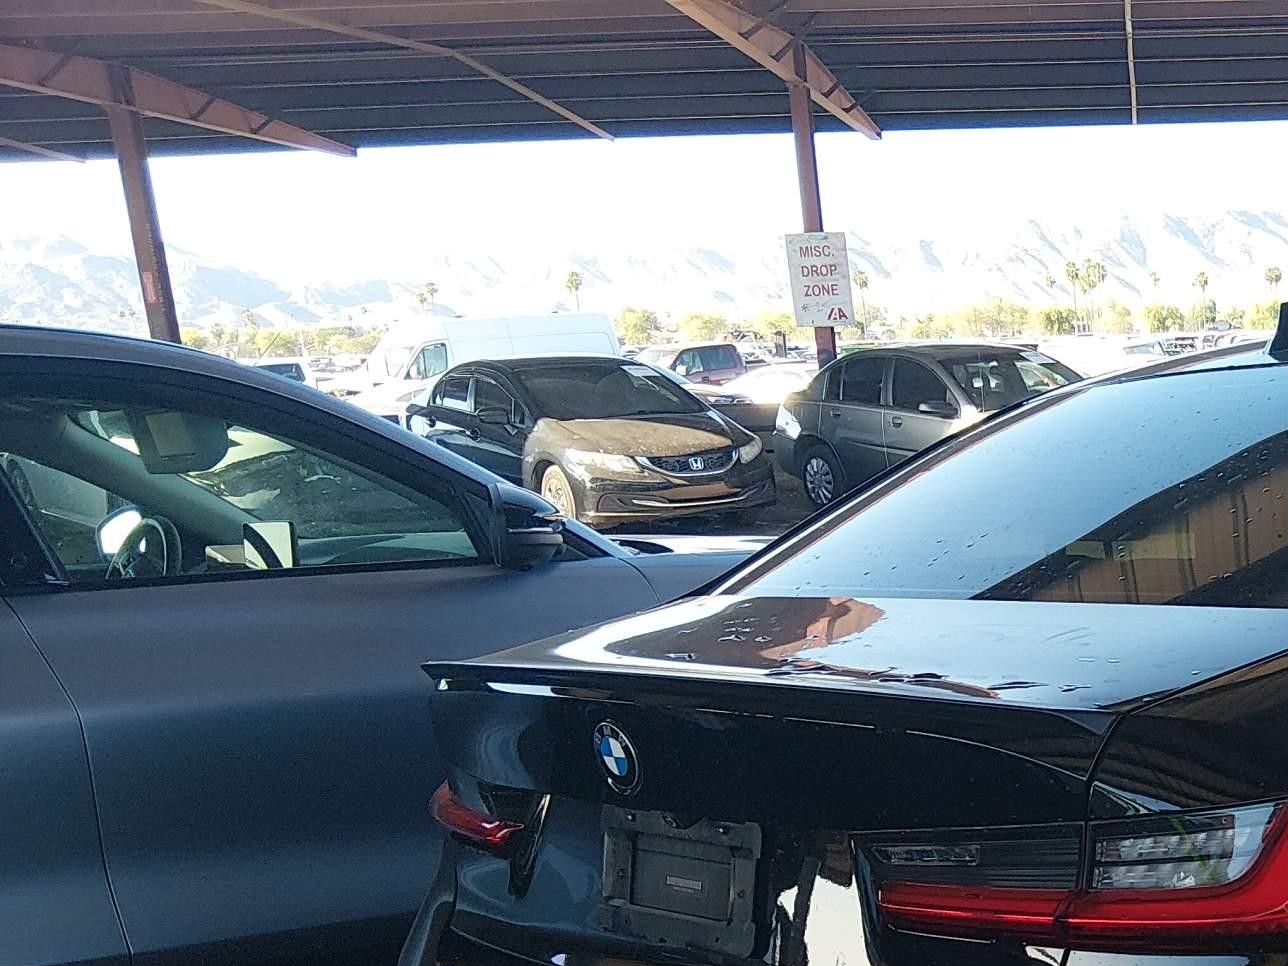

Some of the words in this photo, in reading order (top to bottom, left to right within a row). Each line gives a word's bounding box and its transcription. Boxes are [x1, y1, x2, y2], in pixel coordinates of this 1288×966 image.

[799, 244, 835, 258] MISC.
[801, 264, 838, 278] DROP
[803, 283, 840, 297] ZONE
